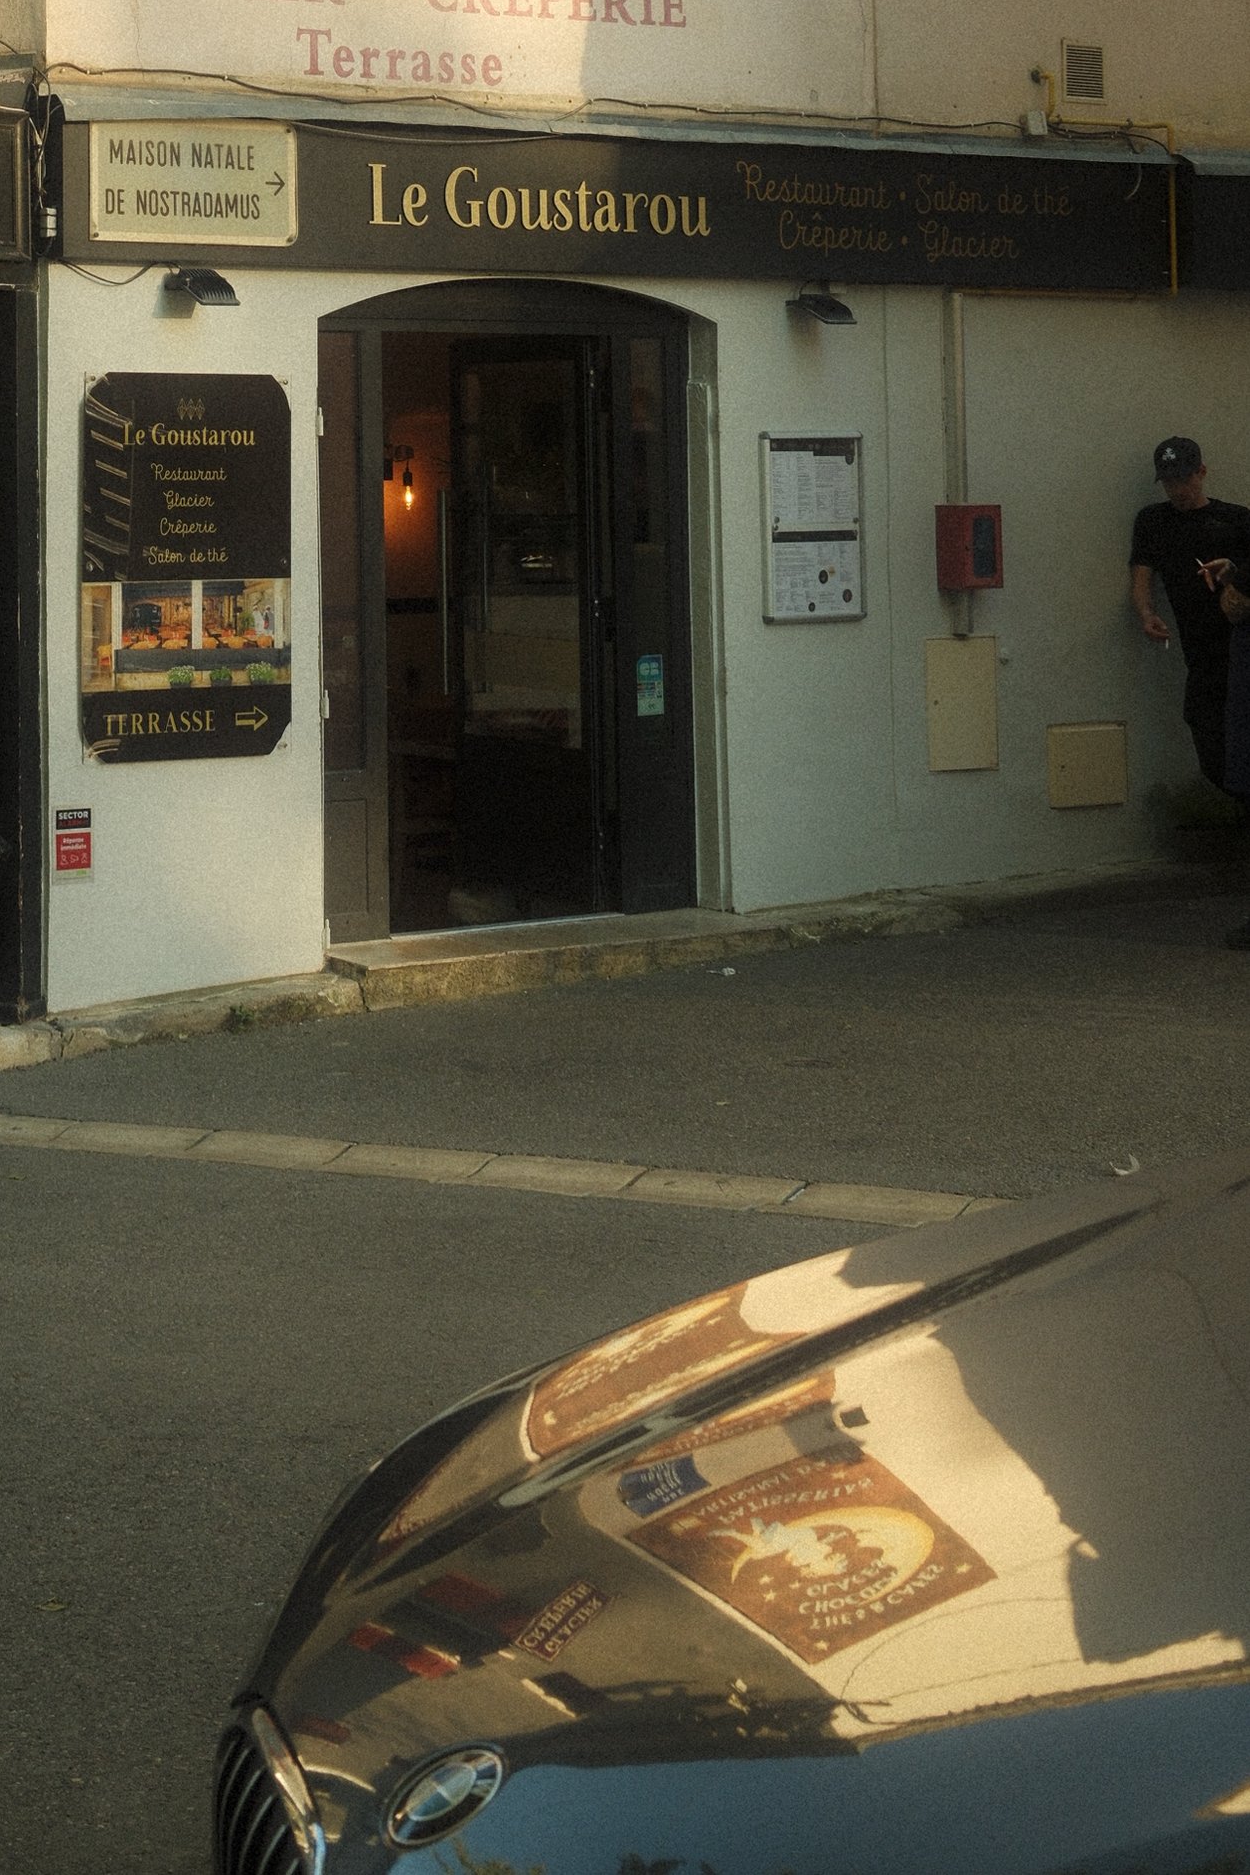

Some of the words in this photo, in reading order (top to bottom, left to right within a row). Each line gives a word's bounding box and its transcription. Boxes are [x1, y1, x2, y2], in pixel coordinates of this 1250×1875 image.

[296, 27, 504, 87] Terrasse
[108, 138, 182, 168] MAISON
[191, 142, 256, 171] NATALE
[367, 162, 429, 227] Le
[444, 165, 711, 238] Goustarou
[737, 160, 892, 210] Restaurant
[916, 173, 989, 215] Salon
[998, 185, 1028, 215] de
[1033, 185, 1074, 217] thé
[105, 187, 126, 215] DE
[135, 188, 261, 221] NOSTRADAMUS
[778, 209, 893, 257] Crêperie
[919, 220, 1021, 263] Glacier
[122, 423, 146, 446] Le
[151, 422, 256, 447] Goustarou
[150, 462, 227, 481] Restaurant
[163, 490, 215, 510] Glacier
[159, 517, 217, 538] Crêperie
[147, 545, 186, 565] Salon
[189, 548, 206, 563] de
[207, 546, 229, 563] thé
[103, 709, 217, 737] TERRASSE
[58, 810, 89, 820] SECTOR
